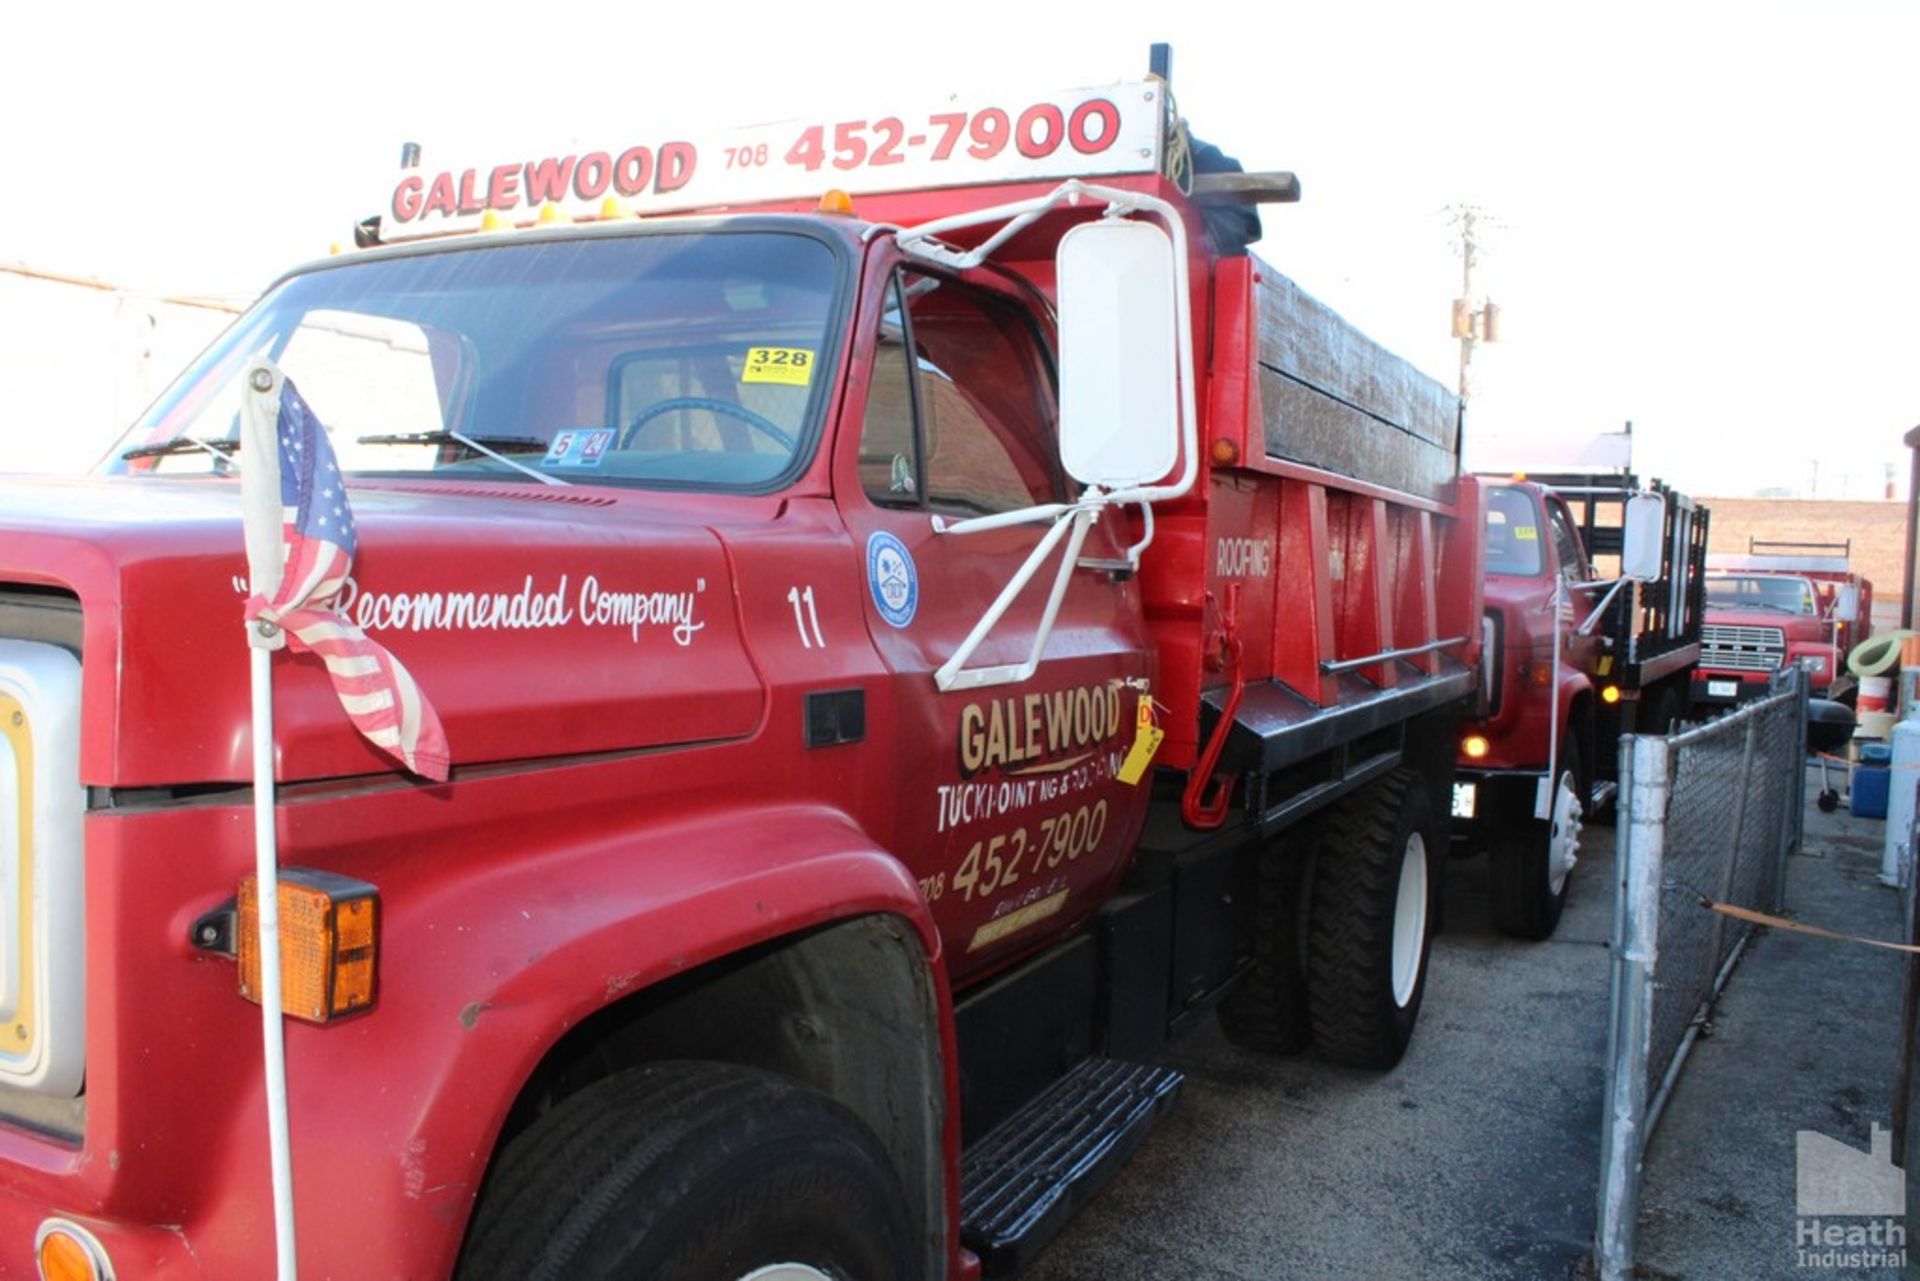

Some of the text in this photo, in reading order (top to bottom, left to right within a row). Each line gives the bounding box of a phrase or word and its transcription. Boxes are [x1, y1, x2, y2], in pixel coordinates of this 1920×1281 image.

[391, 98, 1121, 223] GALEWOOD 708 452-7900
[754, 350, 807, 366] 328
[554, 434, 573, 456] 5
[1216, 537, 1270, 578] ROOFING
[787, 585, 826, 648] 11
[960, 686, 1121, 776] GALEWOOD
[1060, 774, 1070, 795] &
[918, 871, 946, 902] 708
[953, 798, 1108, 902] 452-7900
